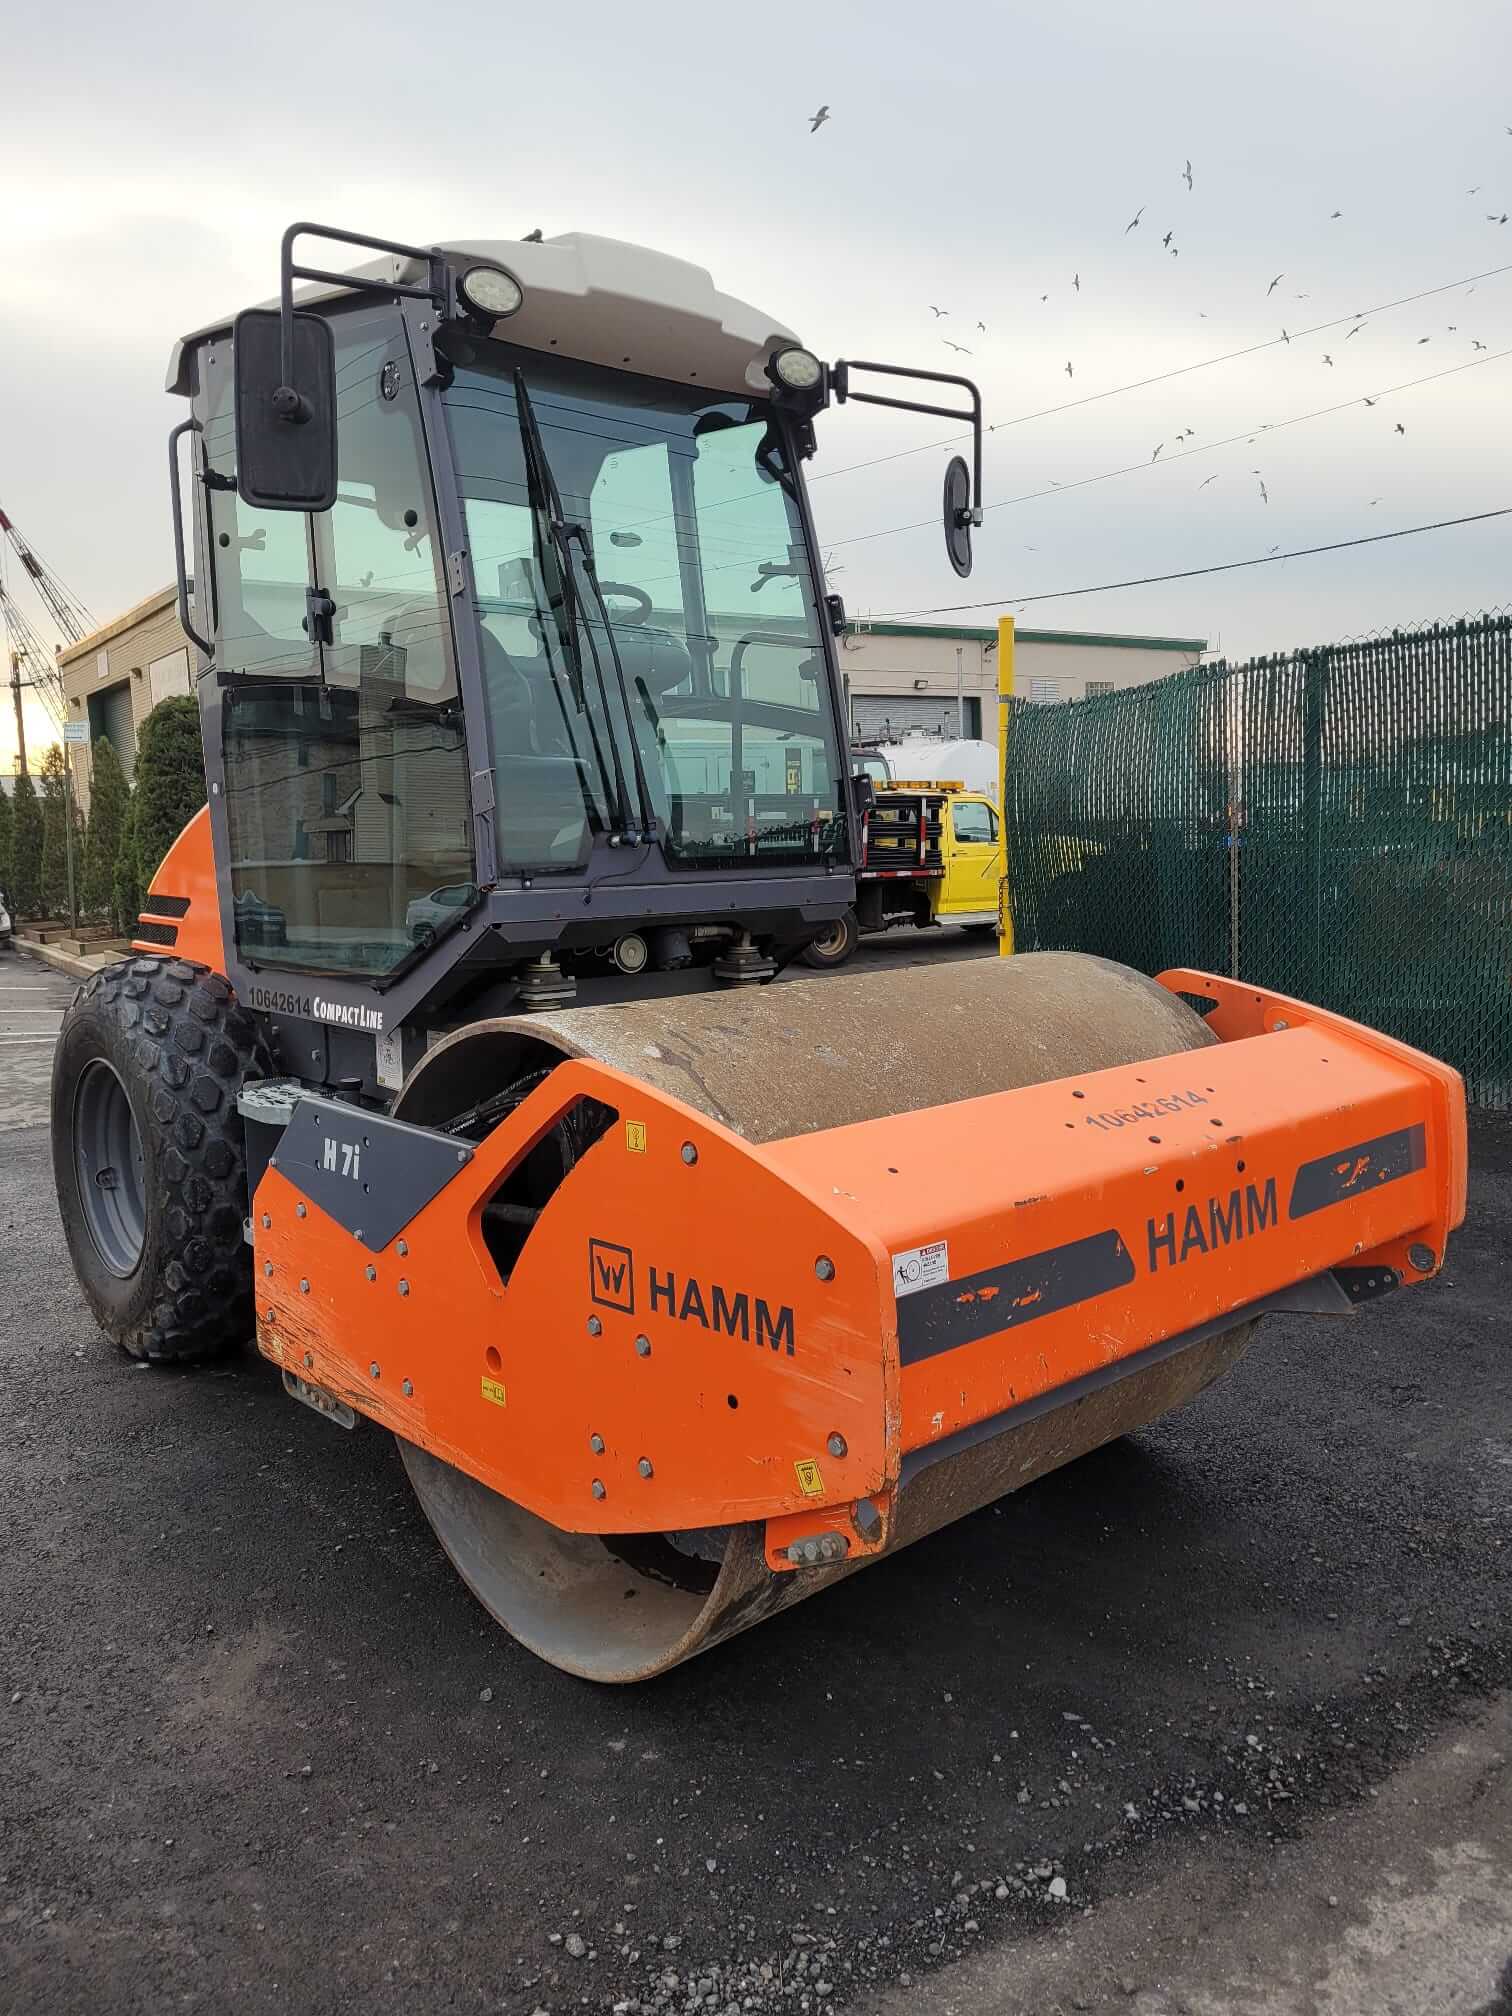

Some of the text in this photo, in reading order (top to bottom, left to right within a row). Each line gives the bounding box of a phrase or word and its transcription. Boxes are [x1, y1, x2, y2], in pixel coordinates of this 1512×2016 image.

[249, 987, 311, 1016] 10642614
[1086, 1091, 1208, 1130] 10642614
[323, 1137, 360, 1180] H 7i
[1147, 1177, 1278, 1273] HAMM
[649, 1266, 795, 1357] HAMM
